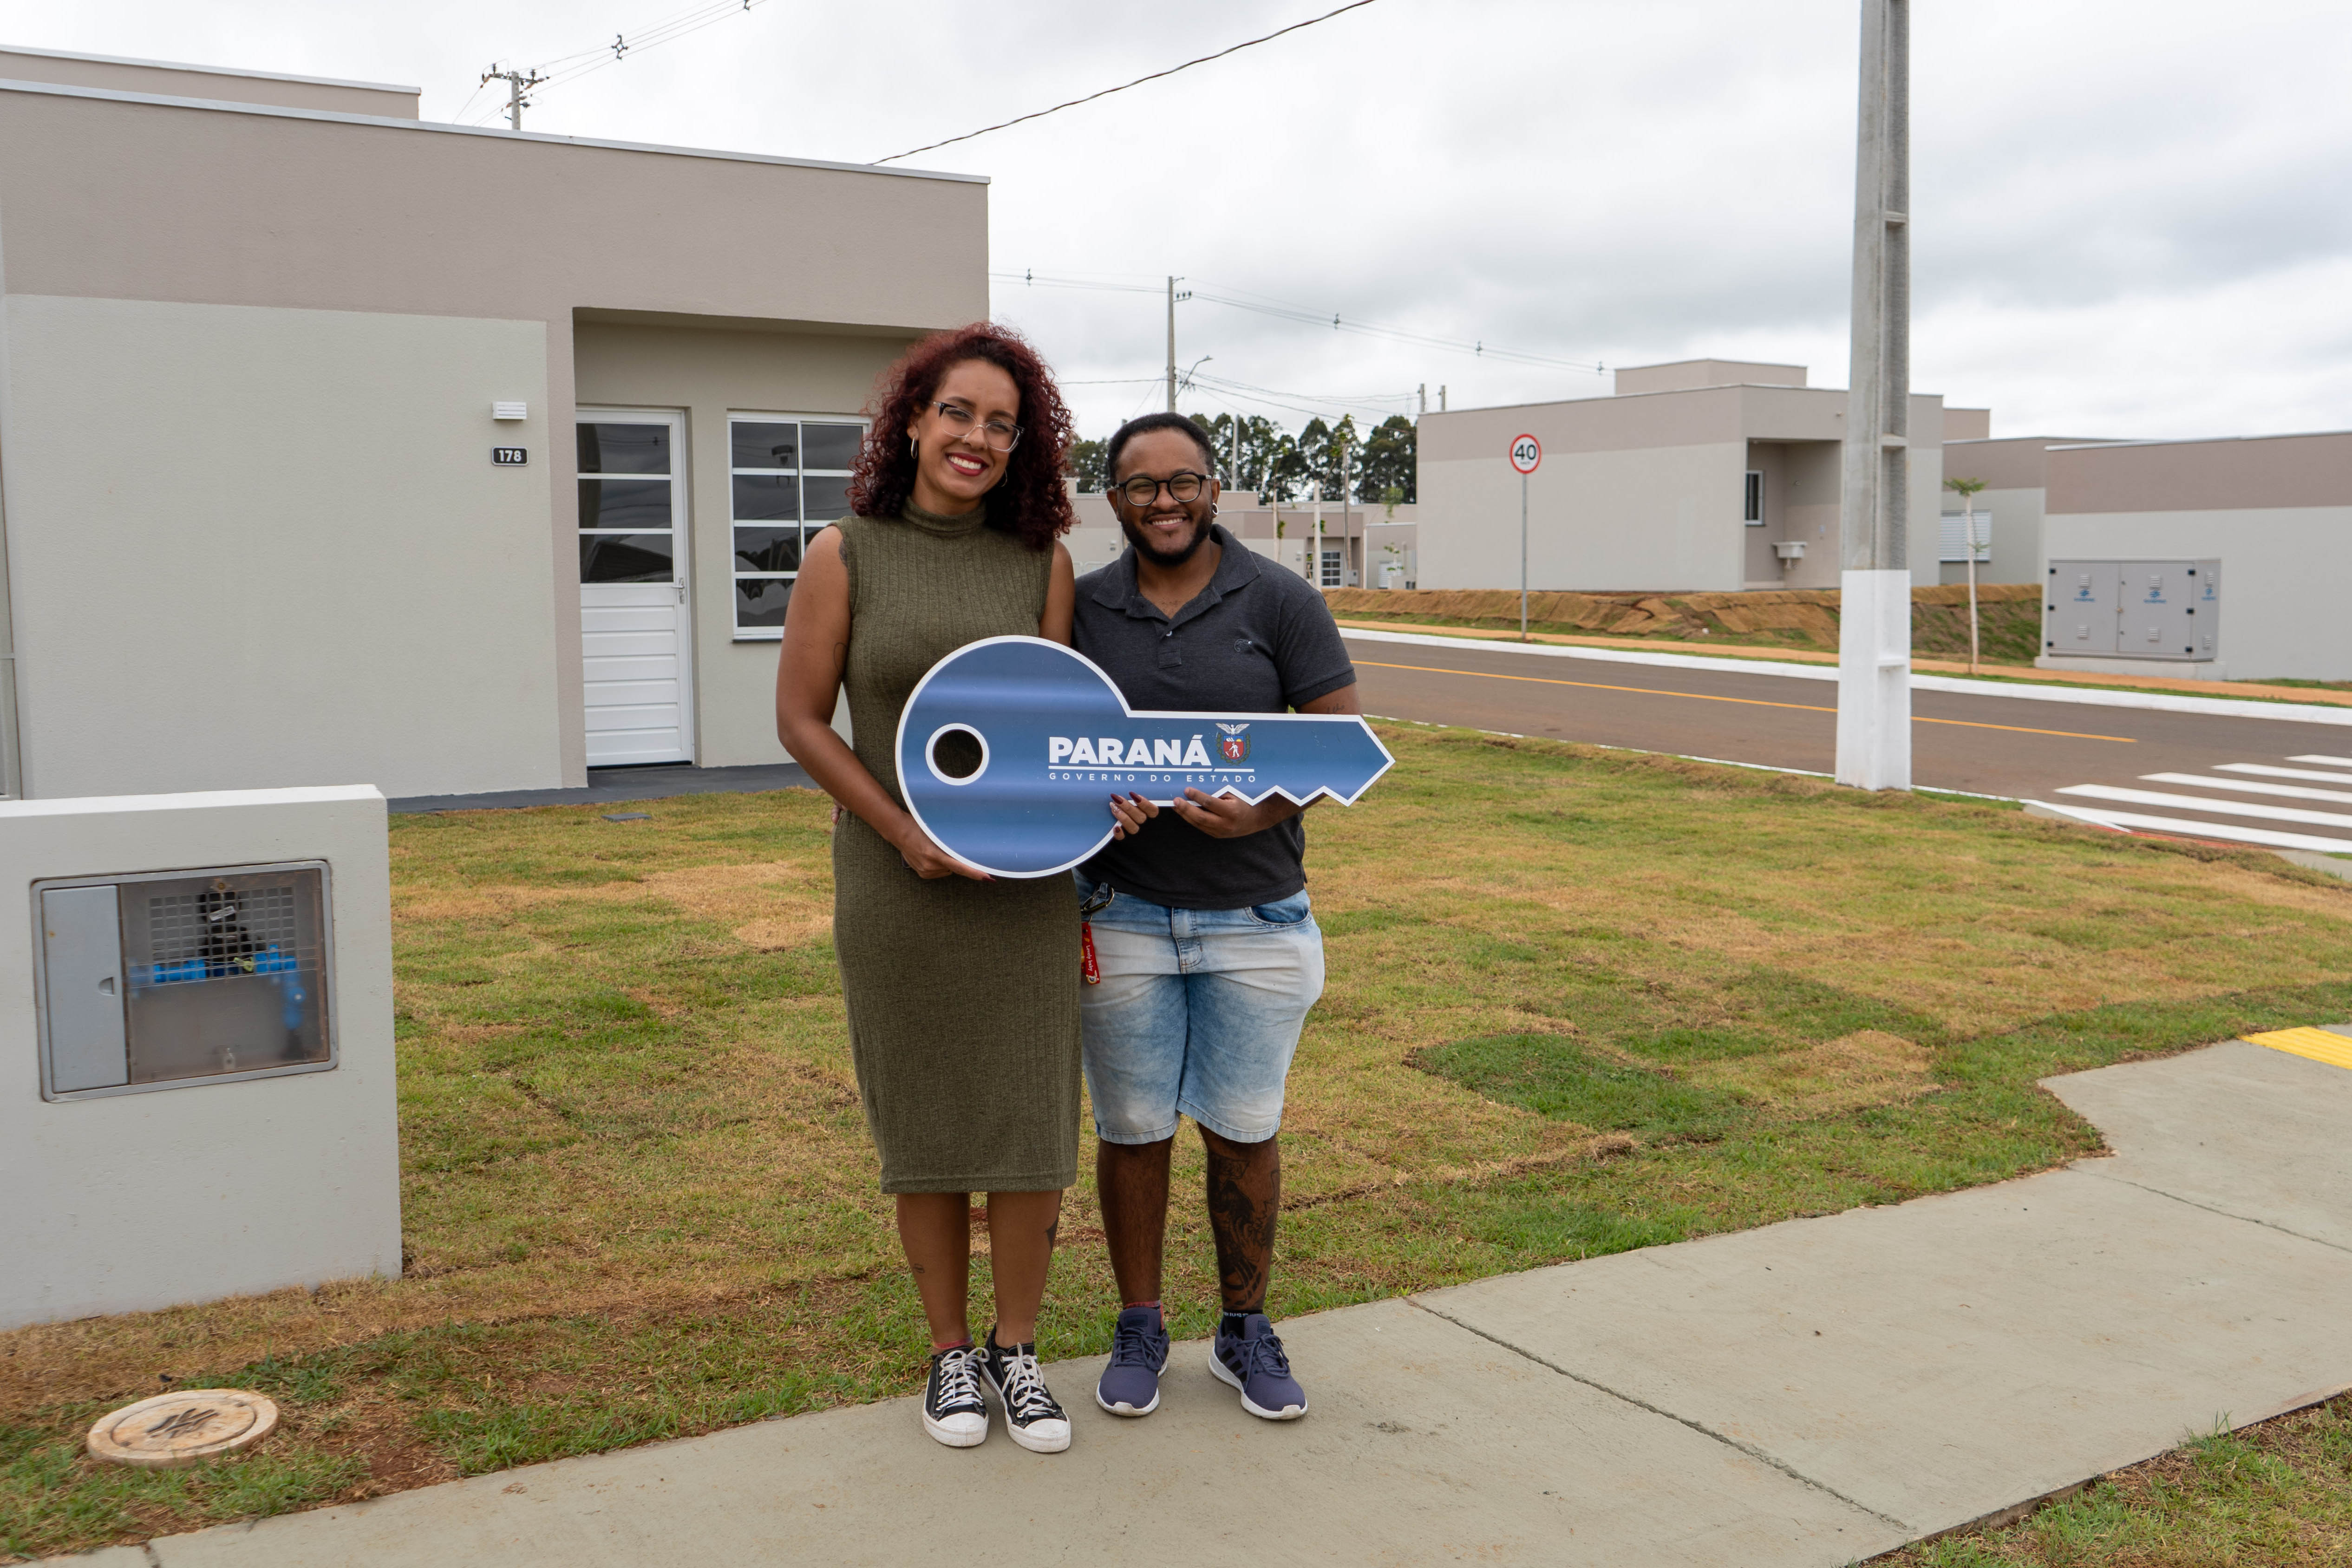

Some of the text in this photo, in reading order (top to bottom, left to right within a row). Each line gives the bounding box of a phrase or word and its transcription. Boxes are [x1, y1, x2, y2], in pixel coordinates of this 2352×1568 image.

[499, 450, 522, 462] 178
[1515, 444, 1536, 460] 40
[1049, 734, 1212, 766] PARANÁ
[1049, 772, 1135, 781] GOVERNO
